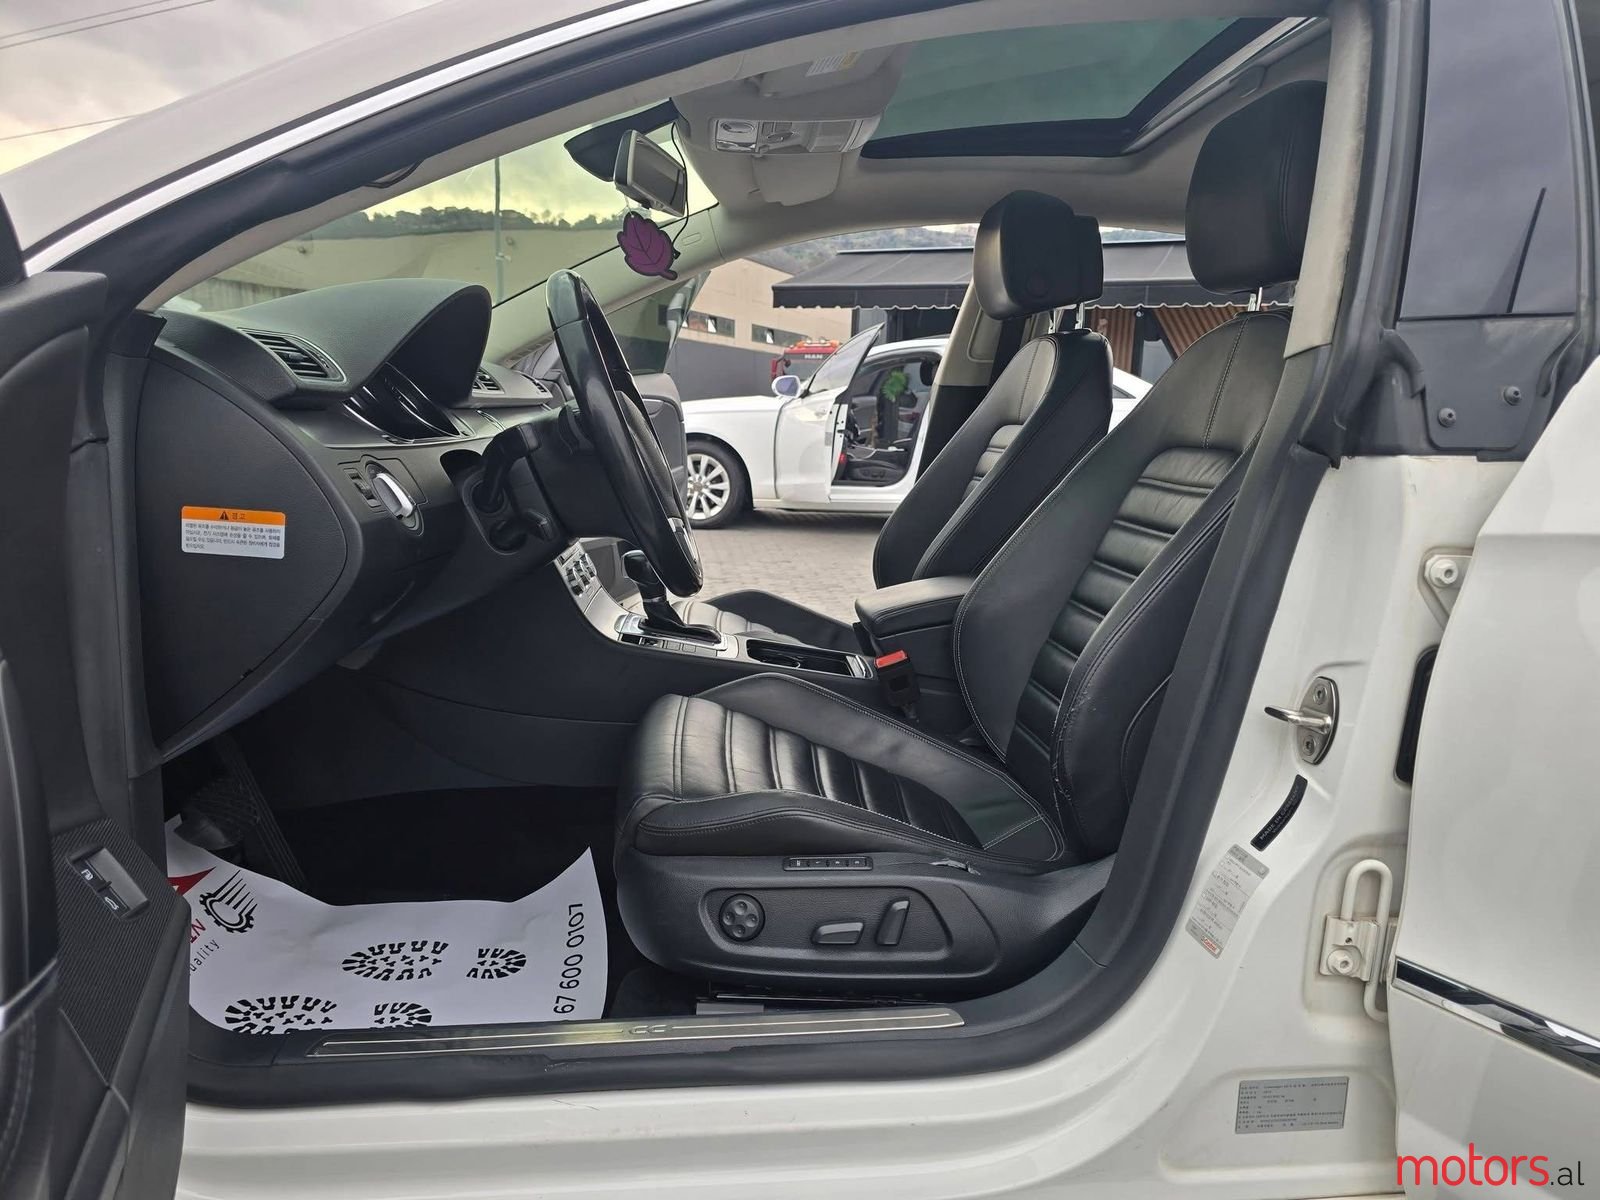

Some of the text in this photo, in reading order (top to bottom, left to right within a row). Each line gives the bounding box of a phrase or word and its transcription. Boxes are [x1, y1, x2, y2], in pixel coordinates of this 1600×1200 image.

[189, 939, 220, 974] uality
[553, 904, 585, 1014] 67 600 0107
